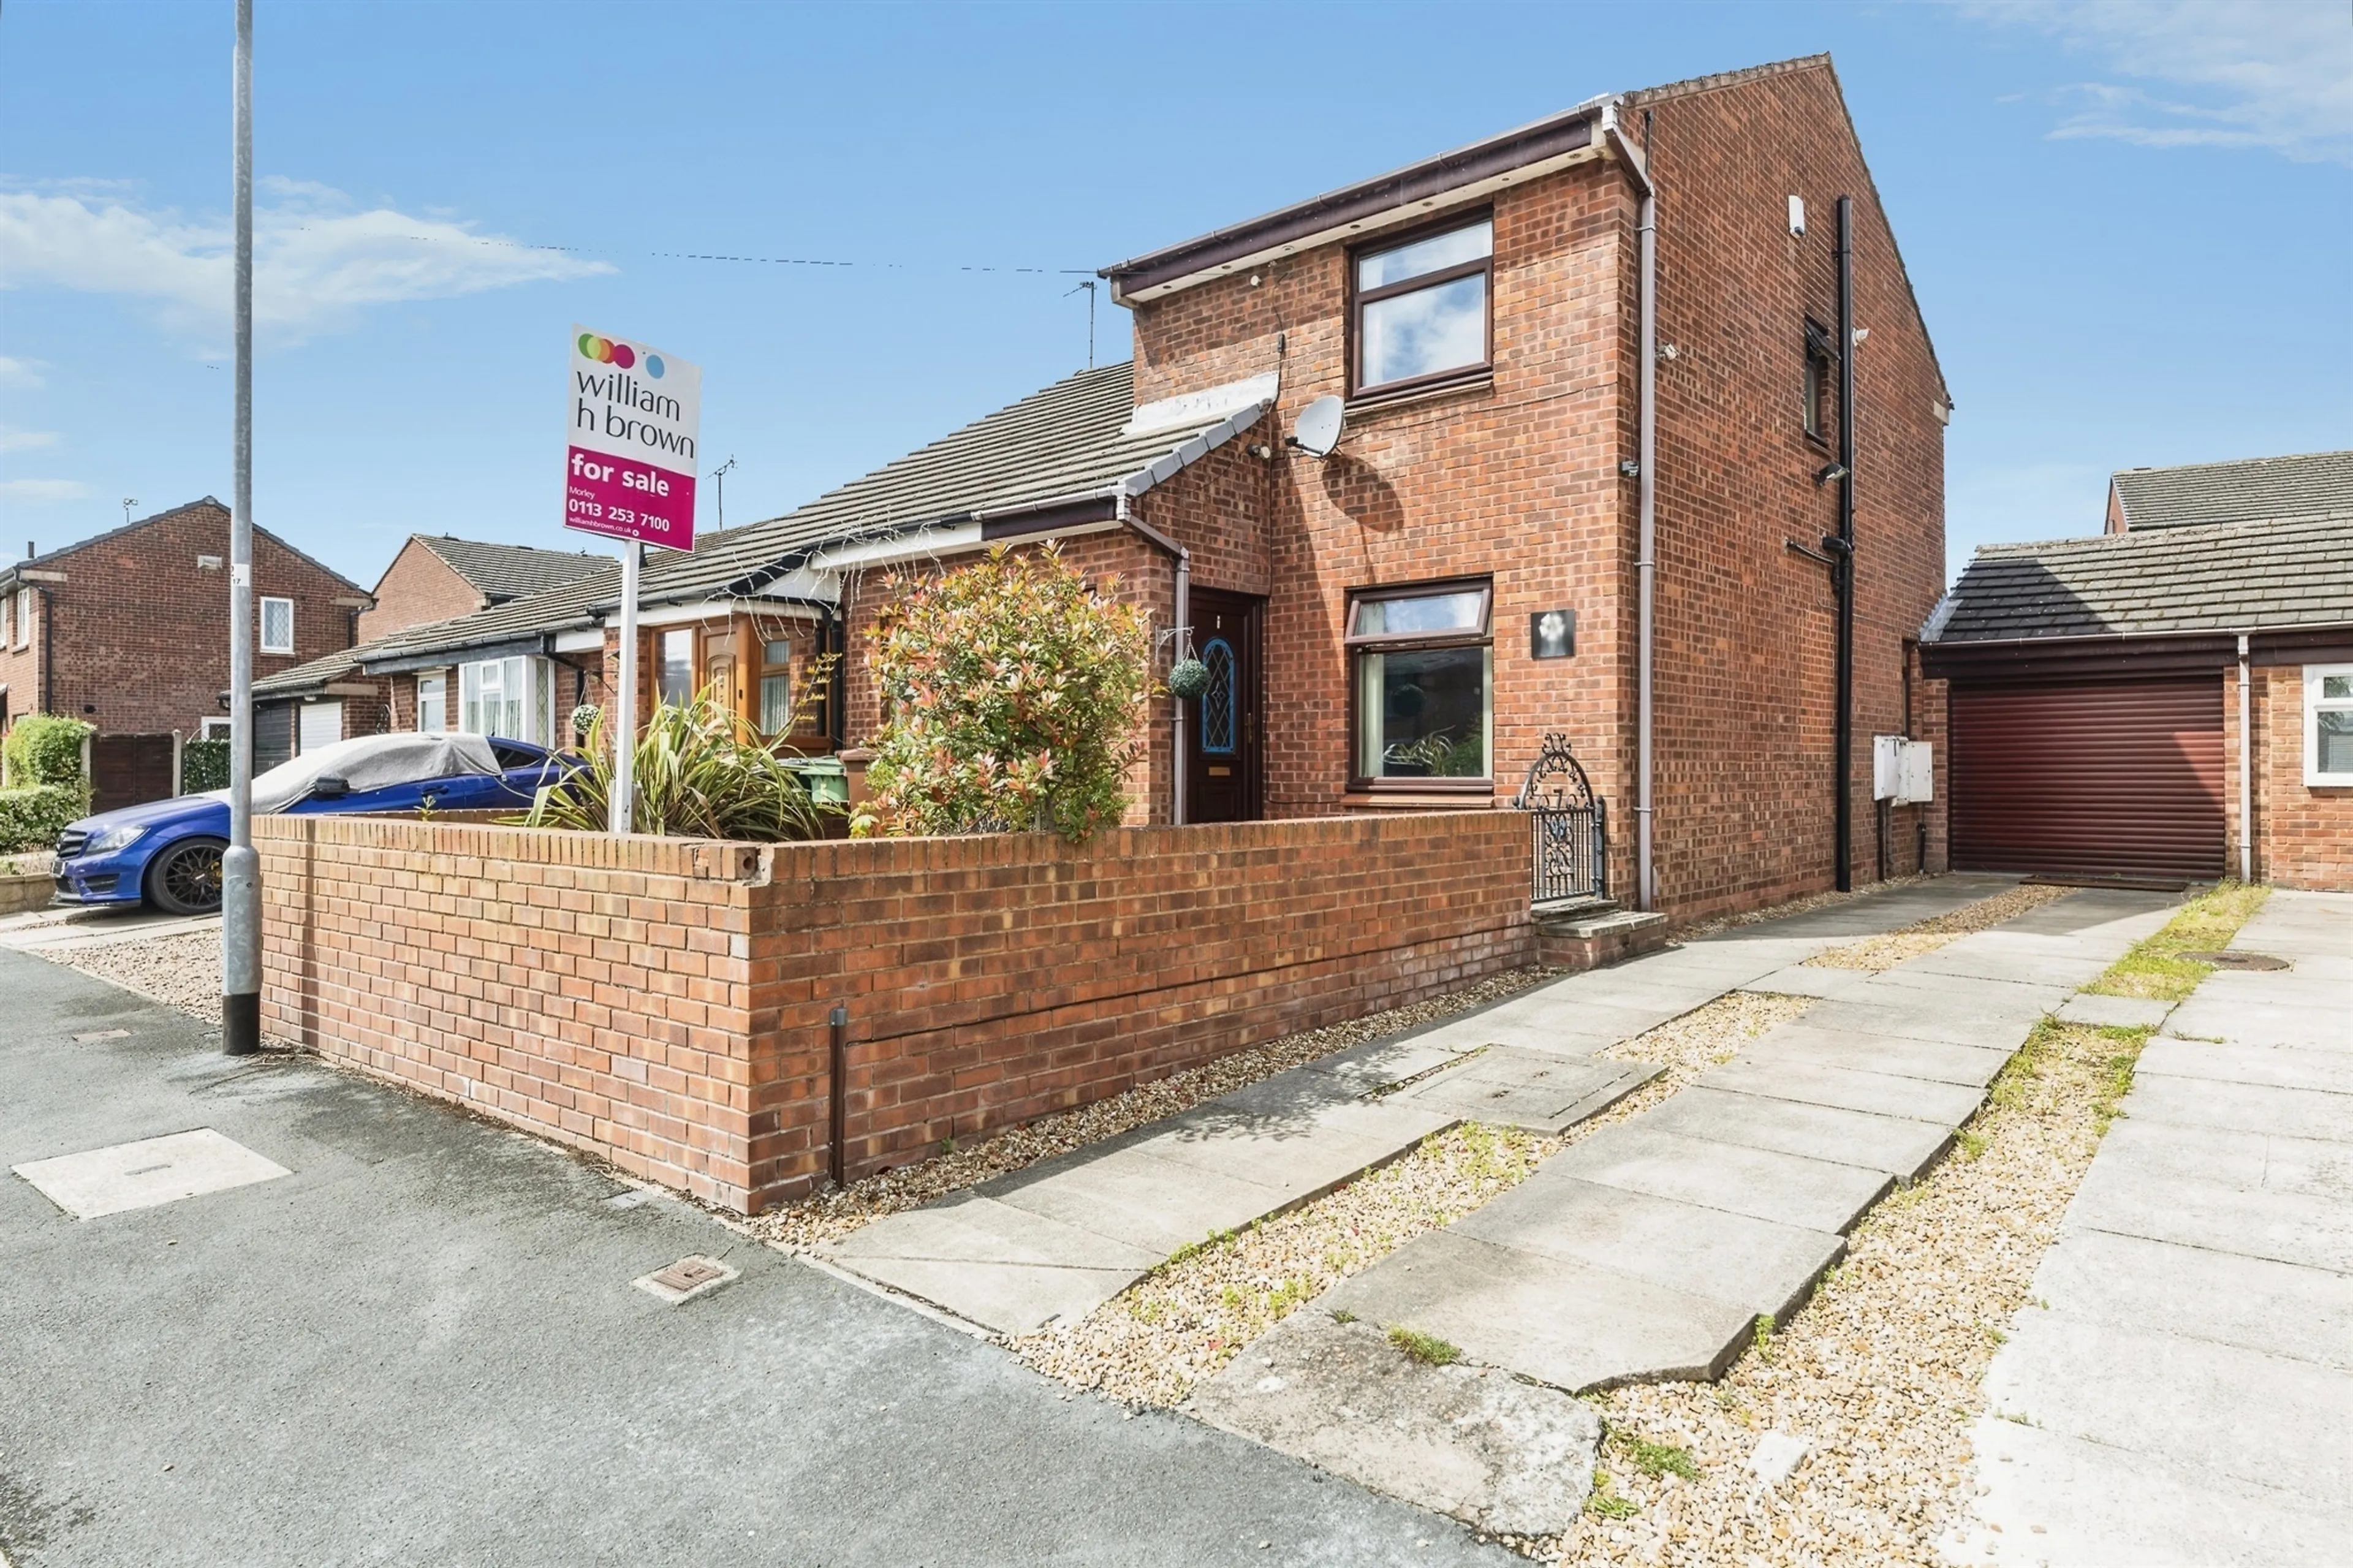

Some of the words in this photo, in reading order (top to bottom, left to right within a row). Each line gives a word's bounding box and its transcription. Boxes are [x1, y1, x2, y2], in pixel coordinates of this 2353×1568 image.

[577, 371, 680, 422] william
[577, 398, 594, 431] h
[606, 404, 694, 459] brown
[571, 453, 615, 482] for
[622, 471, 669, 497] sale
[569, 486, 595, 499] Morley
[569, 499, 602, 517] 0113
[608, 507, 635, 523] 253
[640, 513, 670, 532] 7100
[569, 517, 632, 534] williamhbrown.co.uk
[1553, 789, 1563, 809] 7
